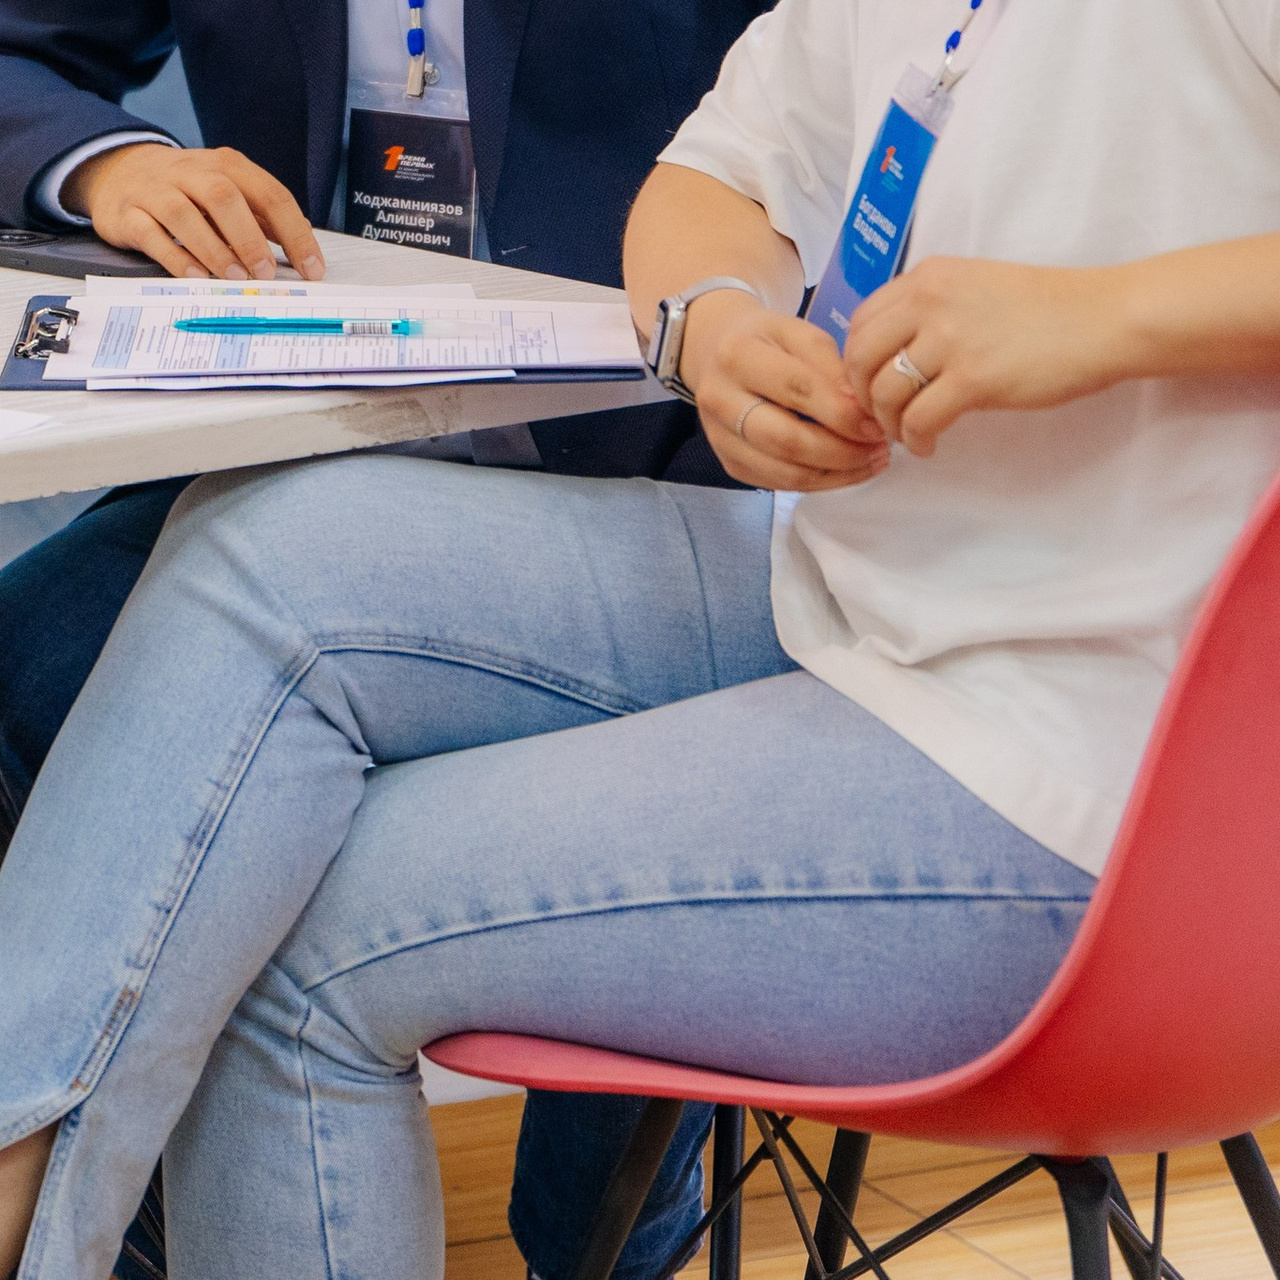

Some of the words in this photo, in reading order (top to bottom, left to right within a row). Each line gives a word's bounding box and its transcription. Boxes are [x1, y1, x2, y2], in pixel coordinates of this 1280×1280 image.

[354, 191, 464, 216] Ходжамниязов
[376, 209, 435, 232] Алишер
[362, 224, 451, 246] Дулкунович
